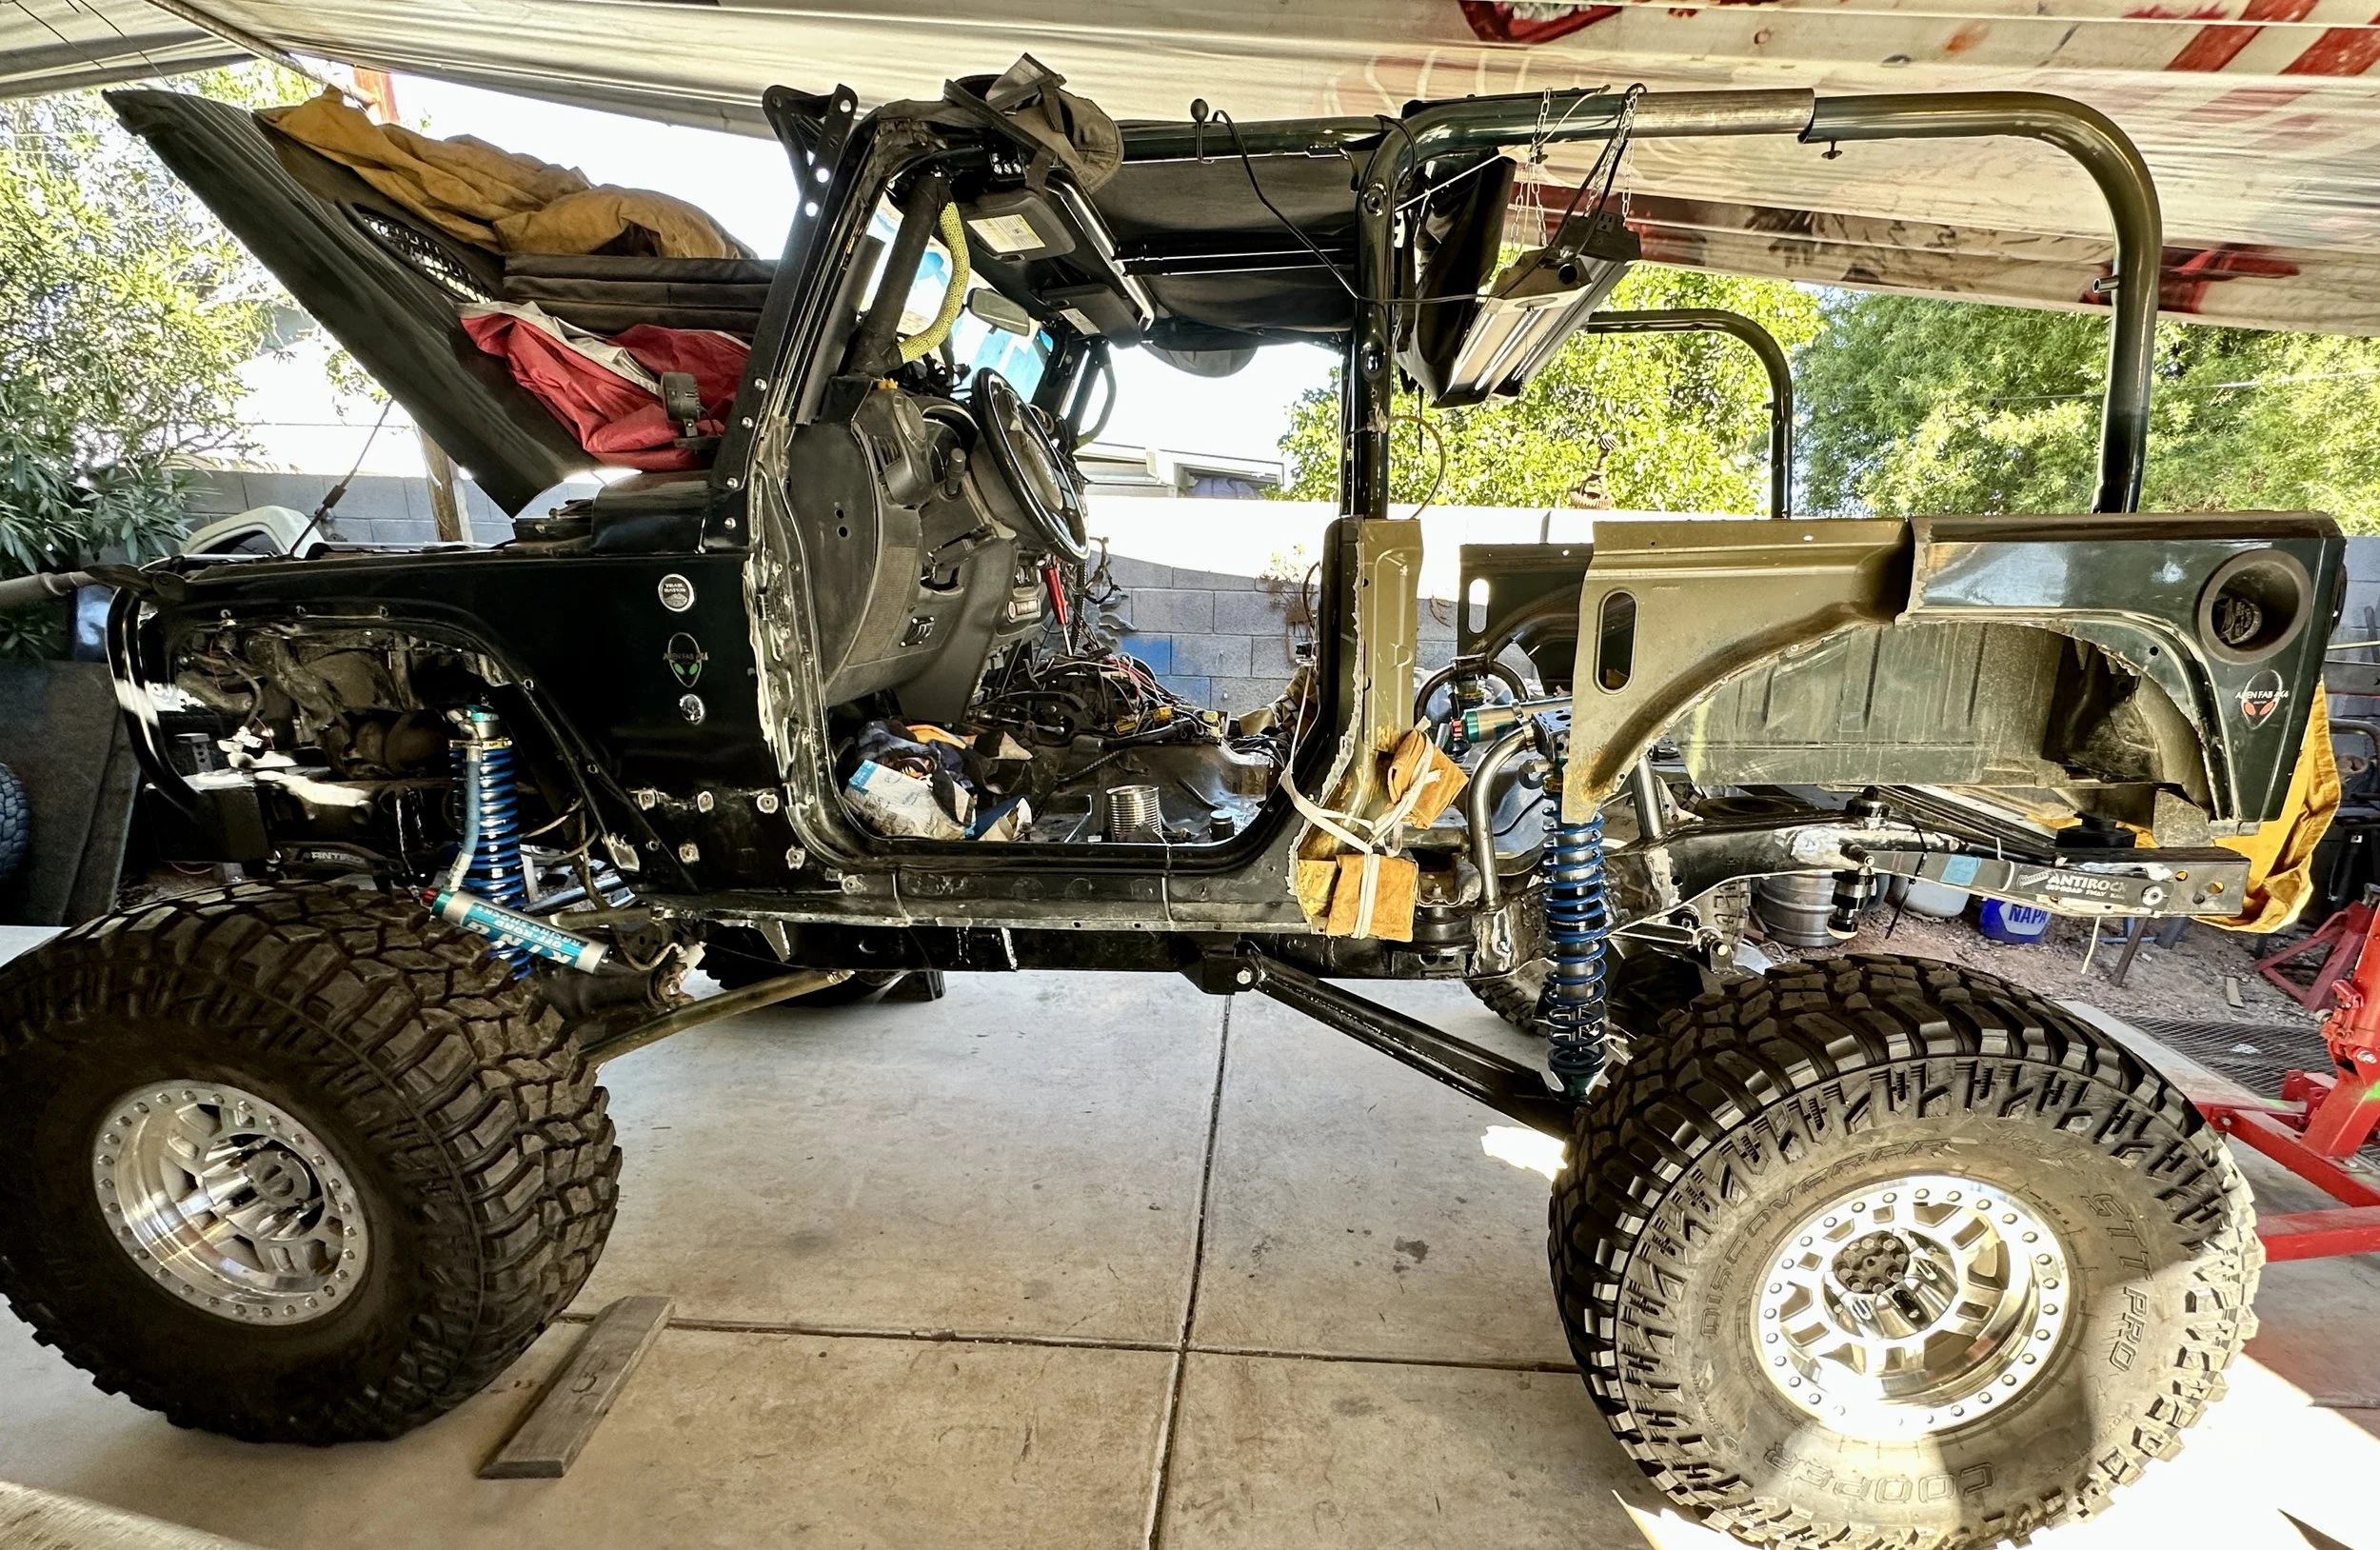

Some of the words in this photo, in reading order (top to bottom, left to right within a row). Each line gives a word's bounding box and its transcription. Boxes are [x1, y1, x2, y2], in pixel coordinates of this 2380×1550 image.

[2257, 690, 2273, 700] FAB
[2047, 873, 2129, 893] ANTIROCK
[477, 904, 528, 929] SHOCKS
[2008, 904, 2048, 924] NAPA
[466, 921, 573, 964] KING
[494, 920, 563, 948] OFF-ROAD
[532, 924, 582, 947] RACING
[1700, 1138, 1952, 1336] DISCOVERER
[2080, 1193, 2155, 1282] STT
[2109, 1285, 2149, 1372] PRO
[1764, 1441, 1995, 1504] COOPER
